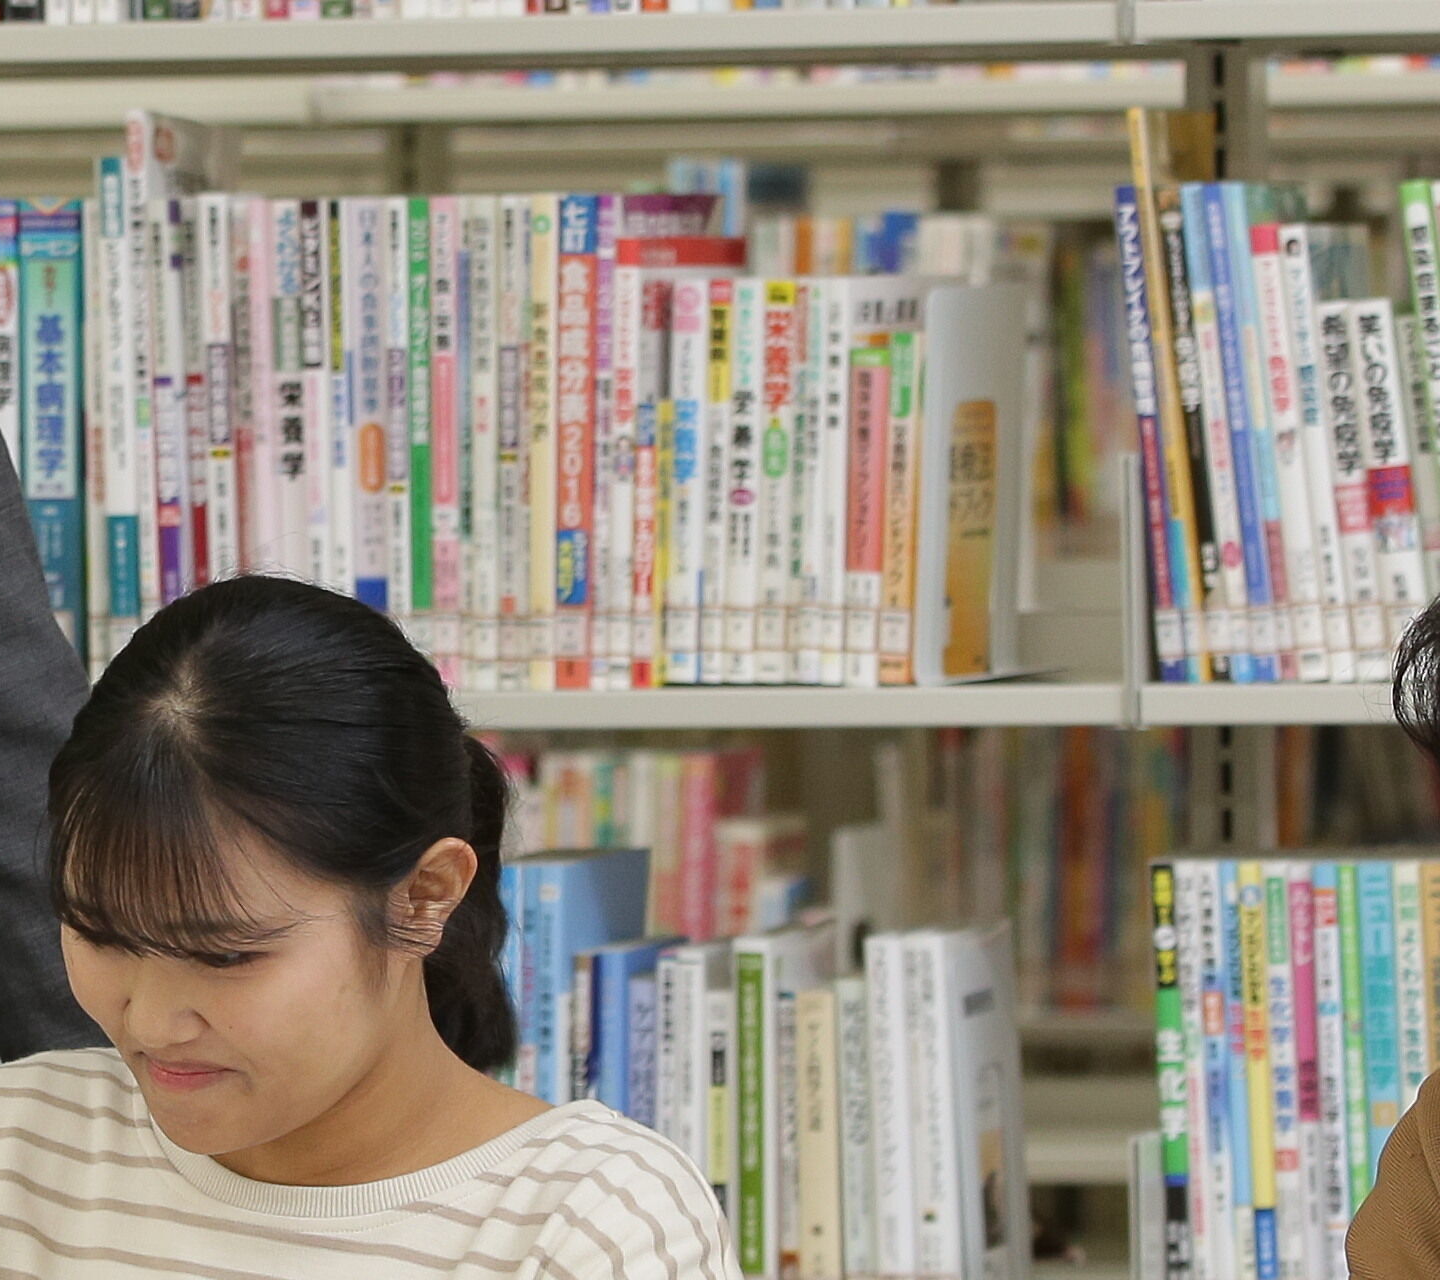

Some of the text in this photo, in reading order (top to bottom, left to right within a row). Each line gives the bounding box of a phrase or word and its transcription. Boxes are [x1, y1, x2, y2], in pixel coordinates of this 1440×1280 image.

[35, 313, 67, 480] 基本病理学
[280, 380, 305, 483] 栄養学
[558, 260, 594, 526] 食品成分表2016
